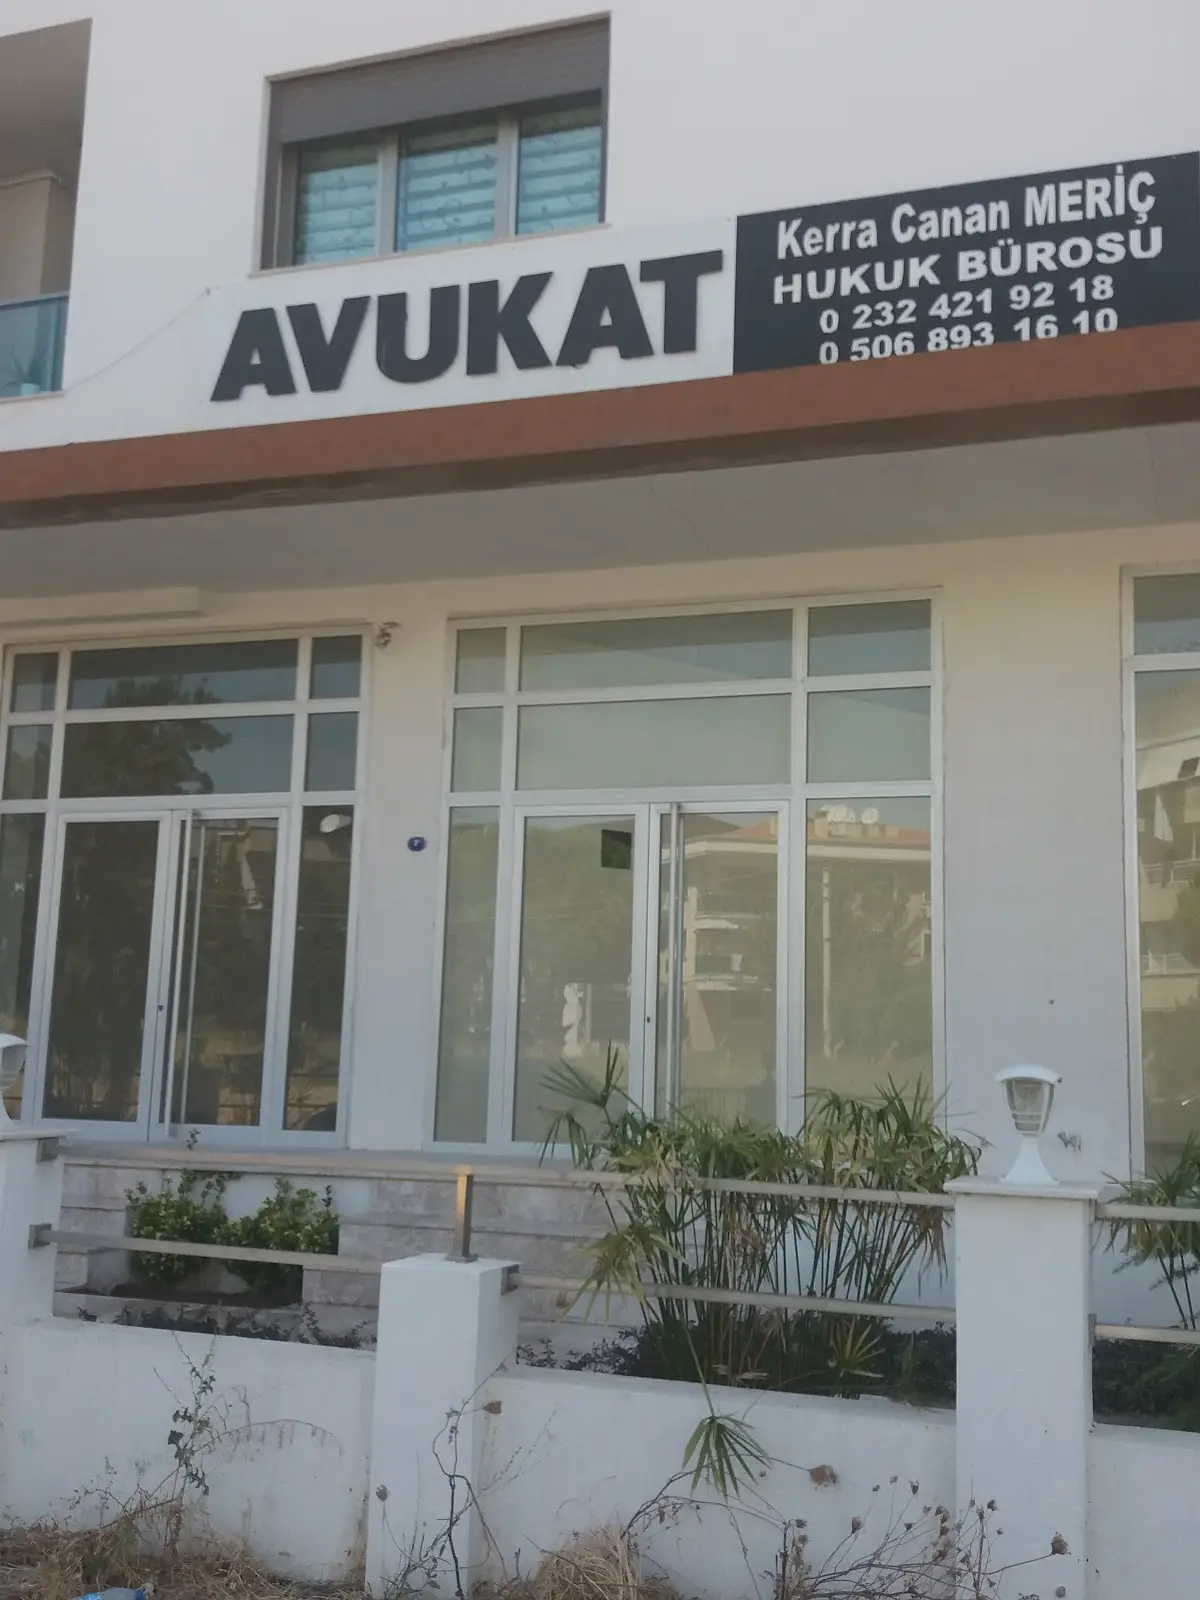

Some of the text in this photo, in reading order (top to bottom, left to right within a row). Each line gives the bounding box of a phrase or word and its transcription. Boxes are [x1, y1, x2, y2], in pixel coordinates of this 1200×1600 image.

[777, 164, 1156, 260] Kerra Canan MERİÇ
[773, 226, 1163, 305] HUKUK BÜROSU
[819, 274, 1114, 334] 0 232 421 92 18
[210, 250, 723, 402] AVUKAT
[819, 307, 1118, 365] 0 506 893 16 10
